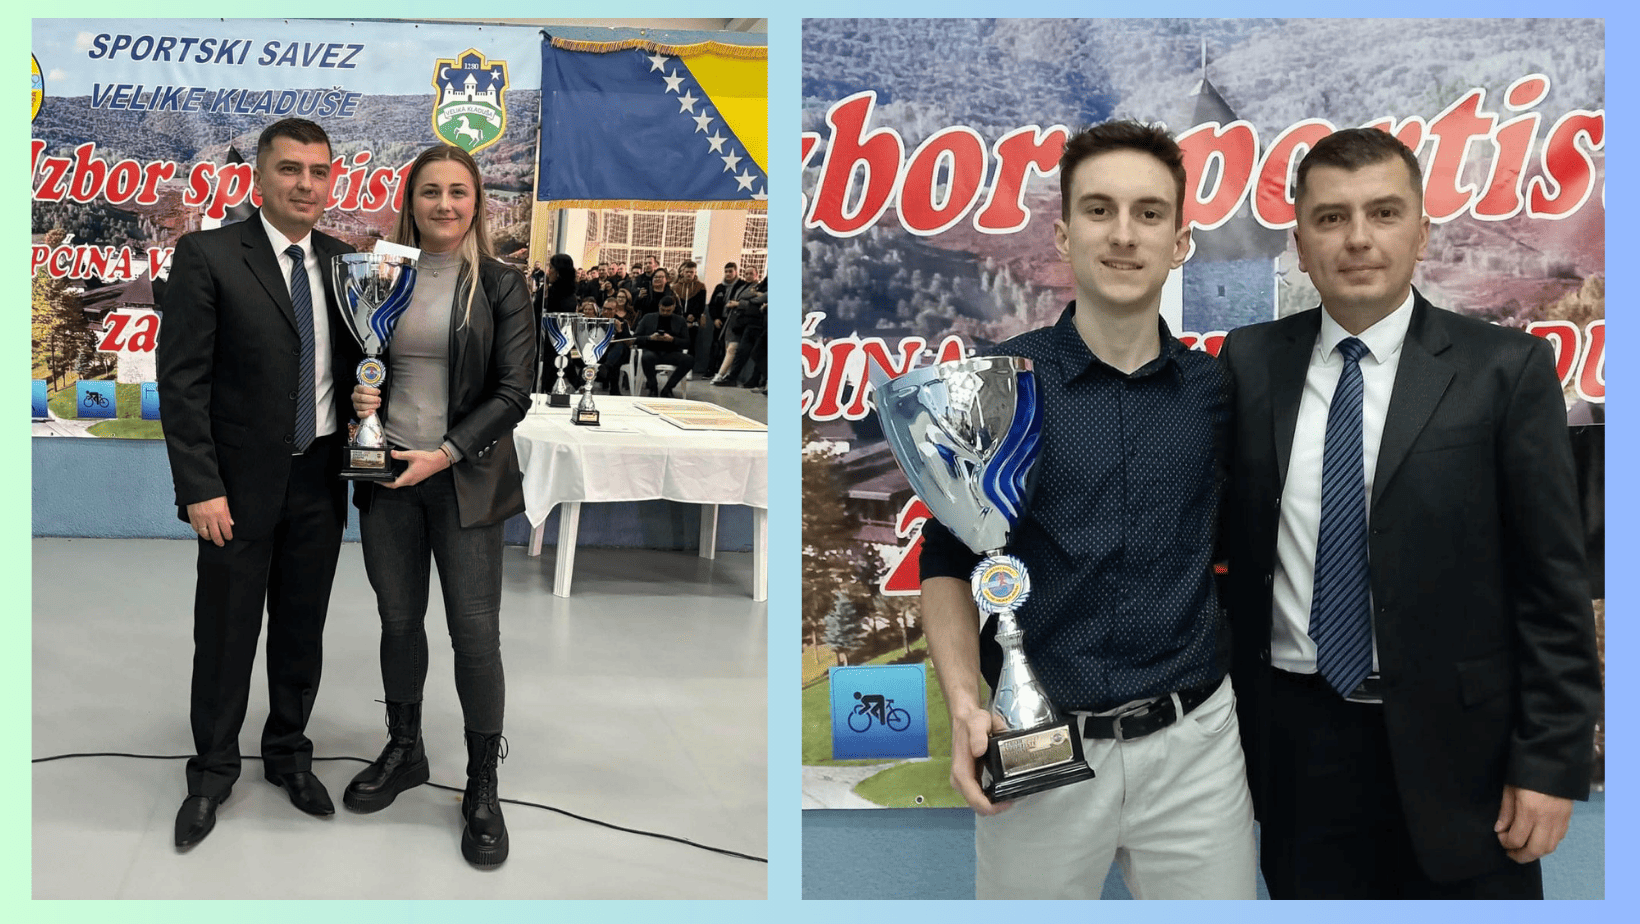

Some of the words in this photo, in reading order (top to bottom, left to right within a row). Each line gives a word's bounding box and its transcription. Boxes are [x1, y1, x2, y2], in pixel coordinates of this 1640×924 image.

[88, 32, 253, 66] SPORTSKI
[257, 40, 365, 69] SAVEZ
[90, 82, 209, 113] VELIKE
[209, 85, 363, 118] KLADUŠE
[802, 90, 1070, 238] bor
[97, 311, 163, 353] za
